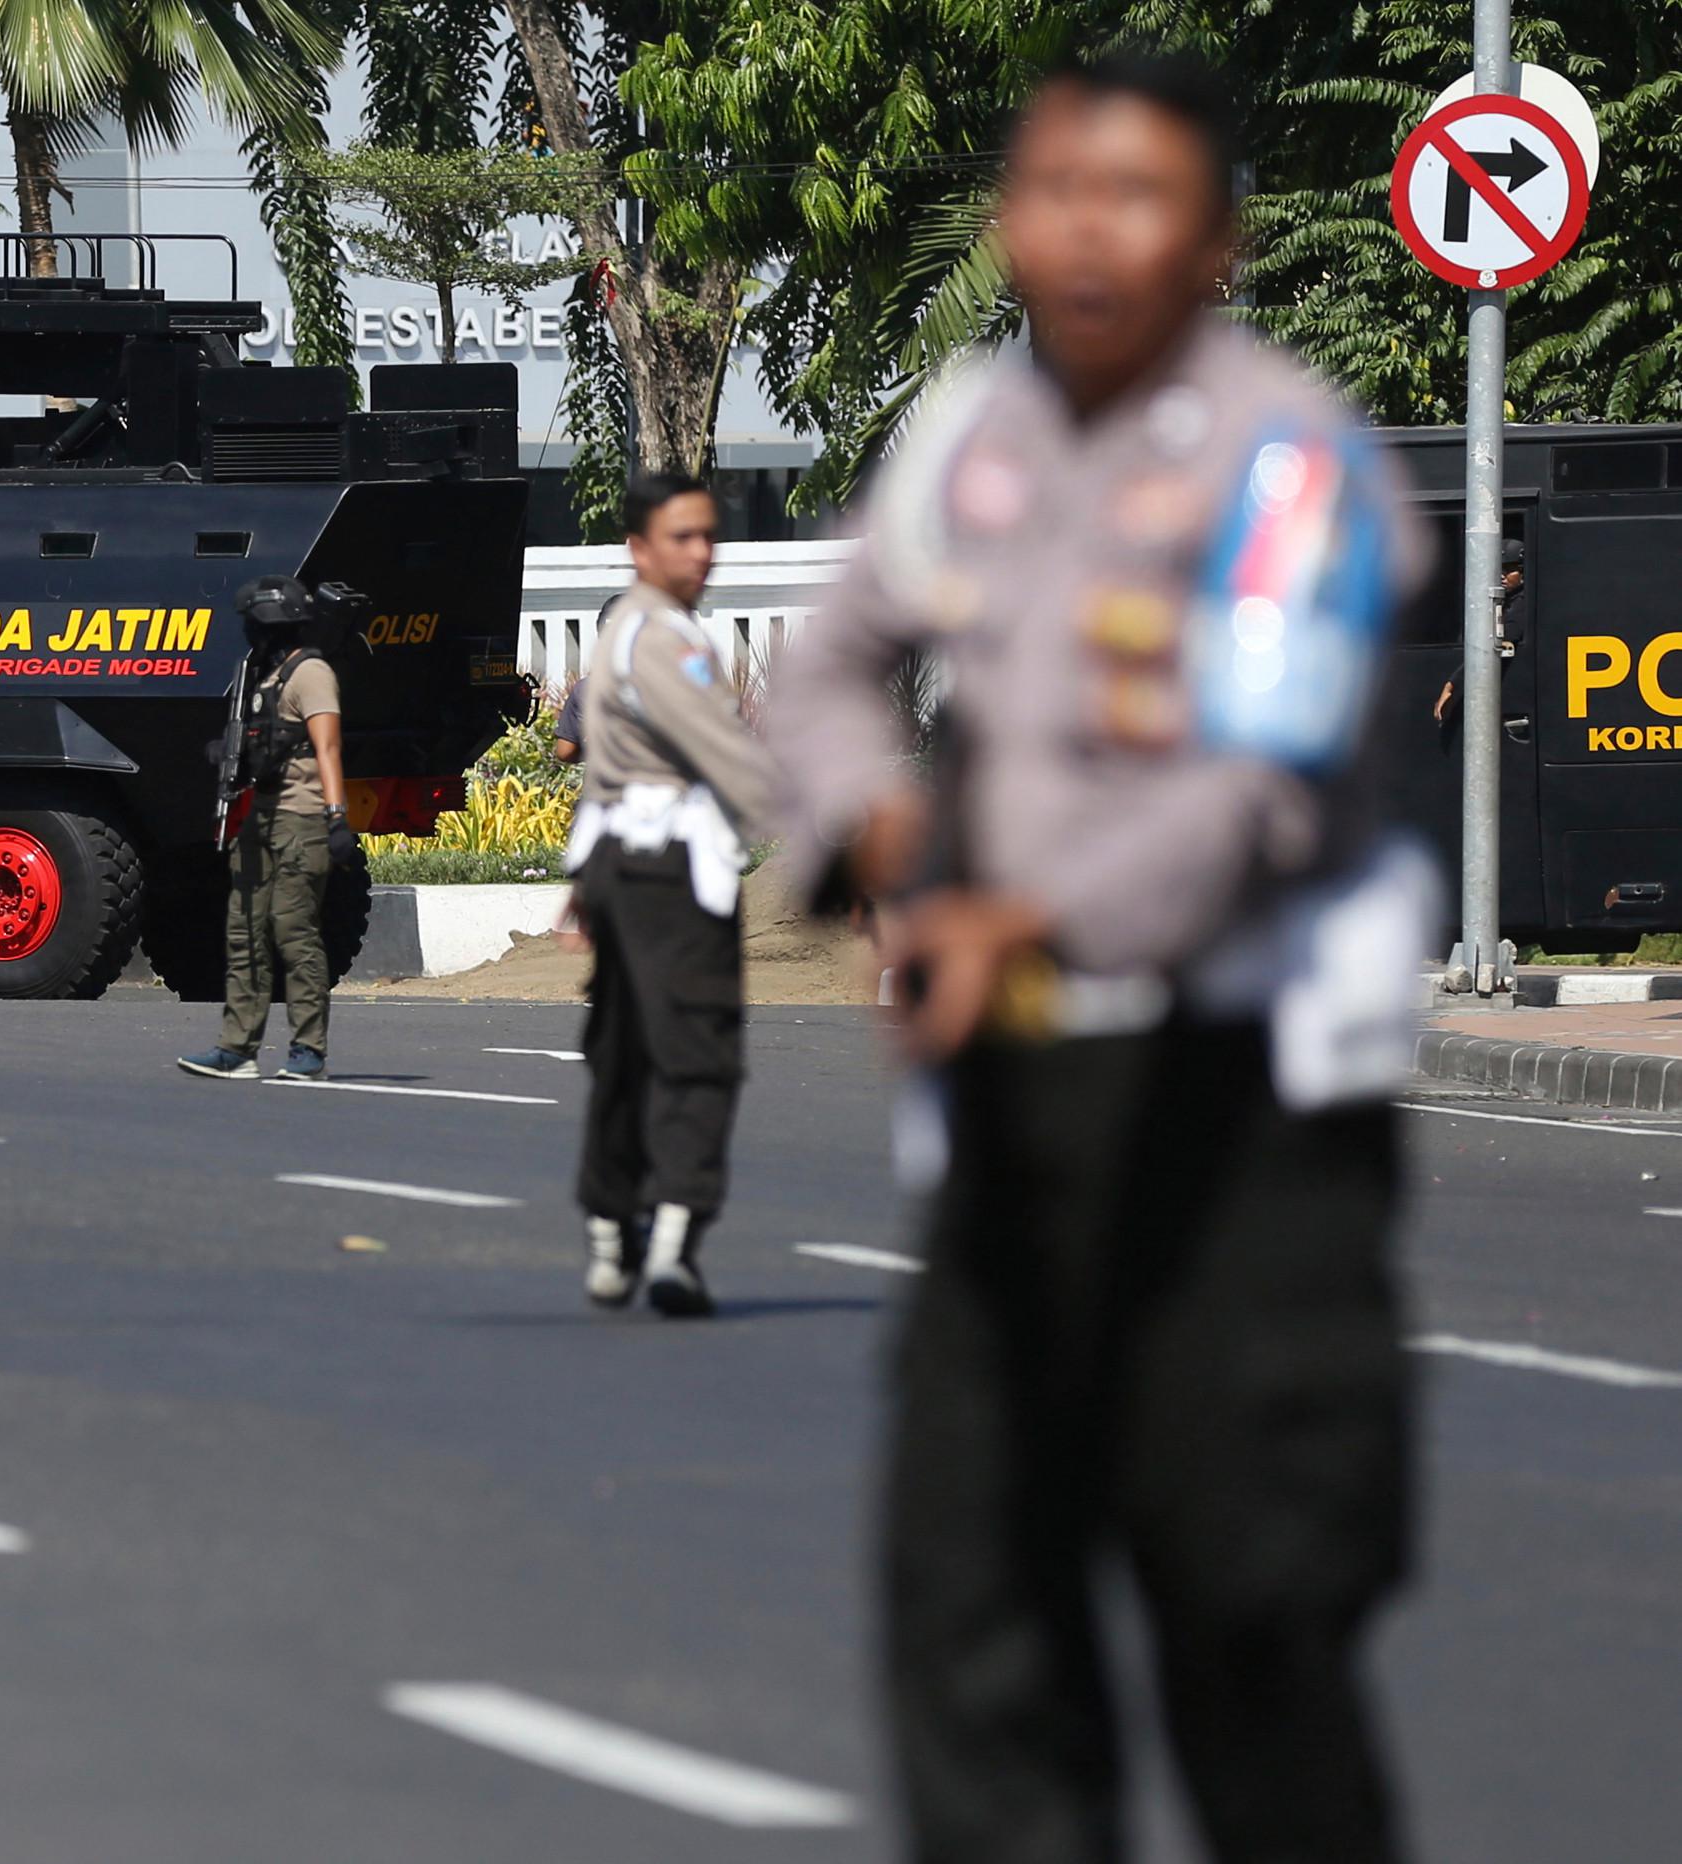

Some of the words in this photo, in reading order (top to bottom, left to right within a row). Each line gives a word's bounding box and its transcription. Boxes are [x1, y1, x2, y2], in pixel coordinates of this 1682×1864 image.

[48, 608, 212, 652] JATIM
[368, 613, 439, 646] OLISI
[108, 658, 197, 676] MOBIL
